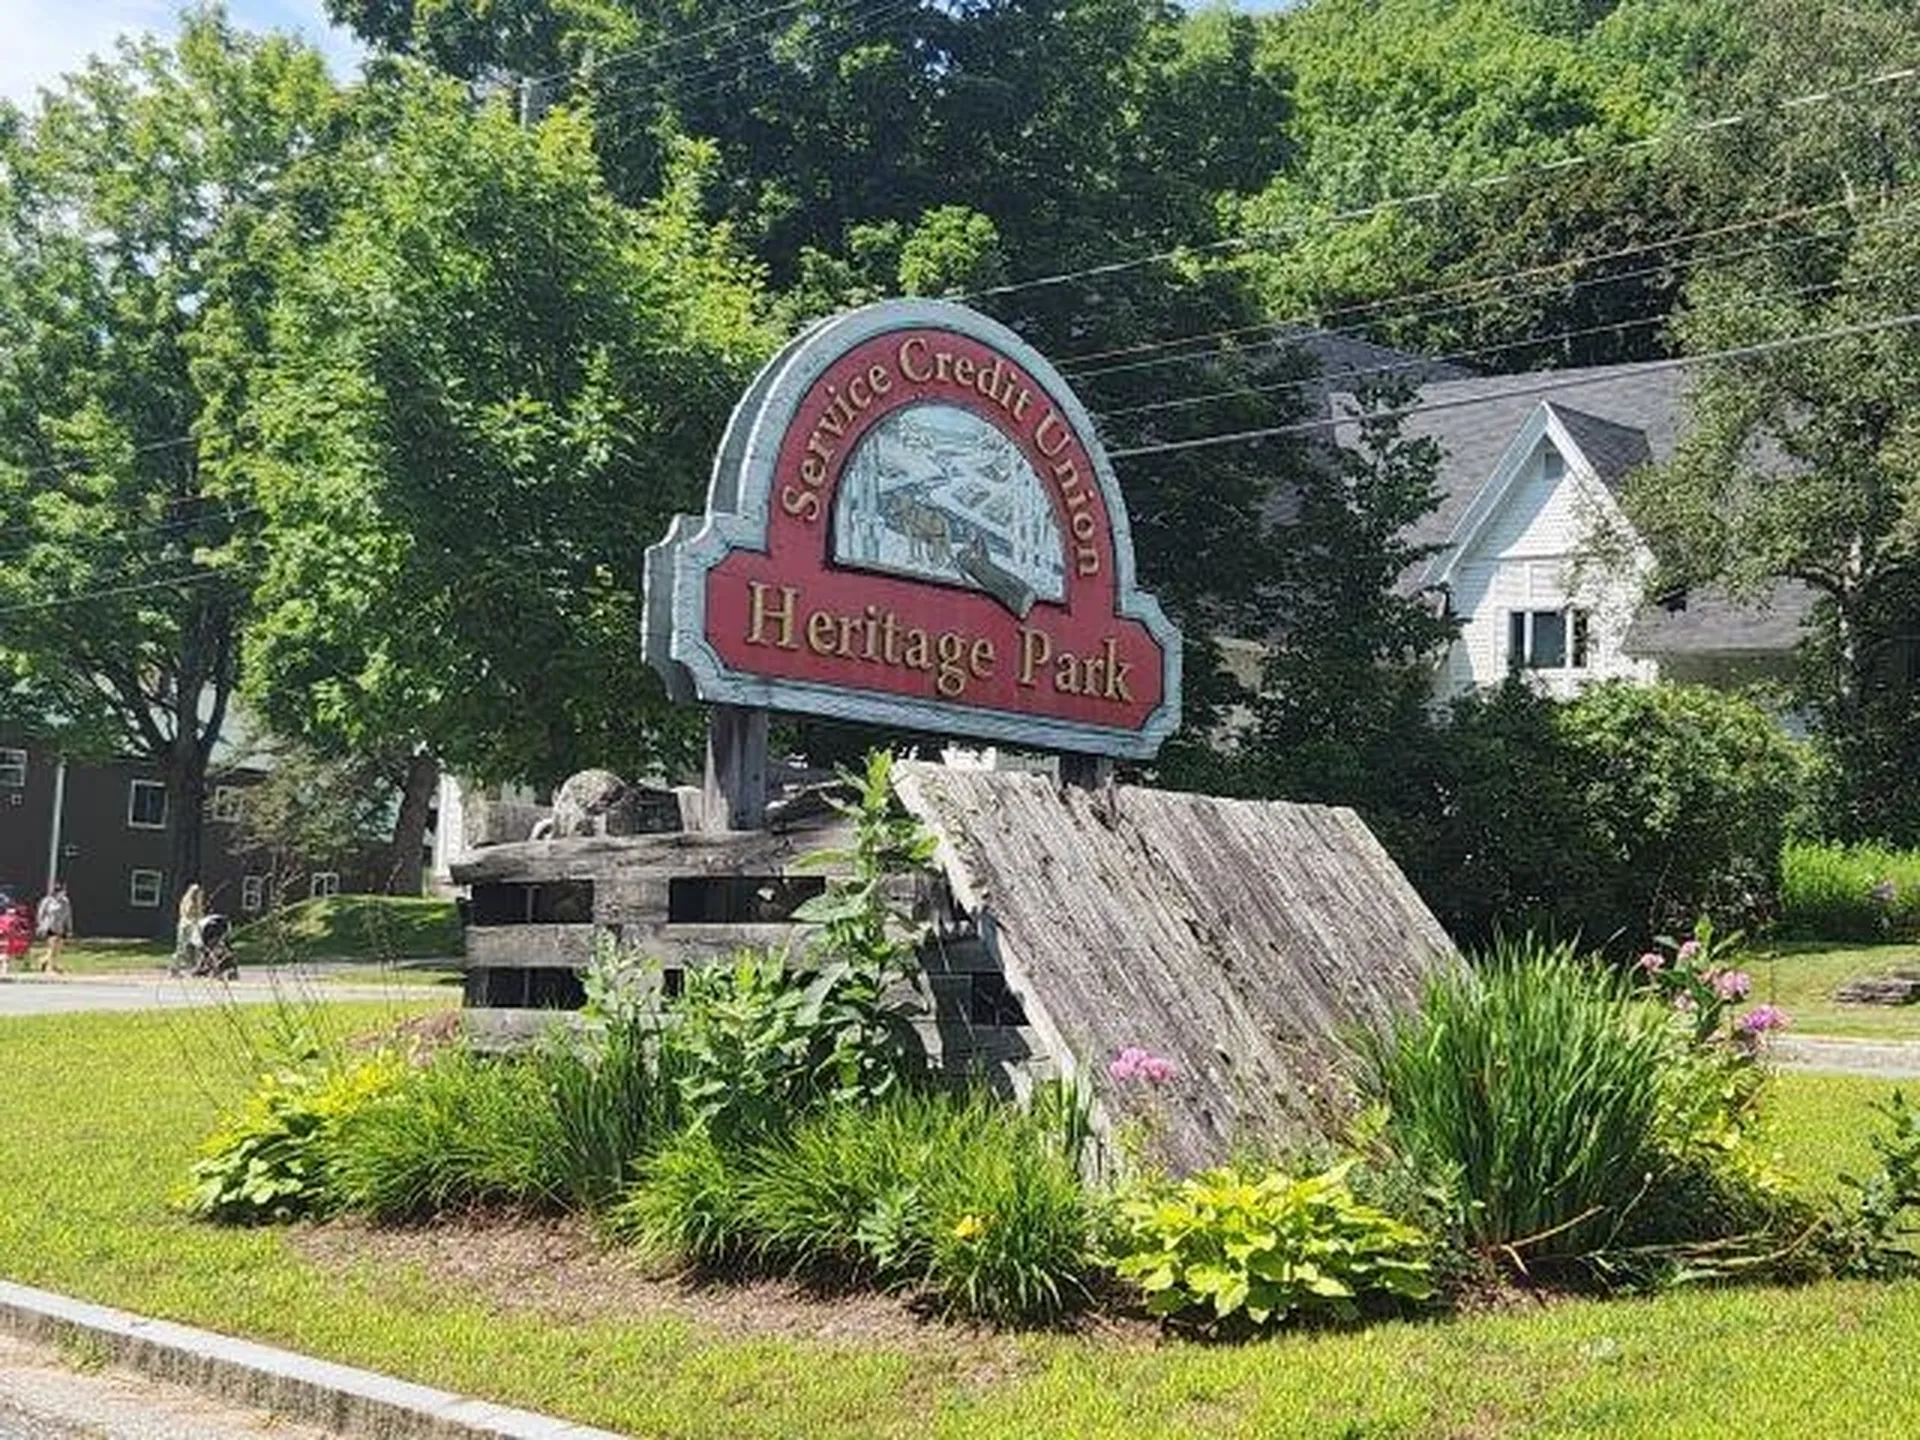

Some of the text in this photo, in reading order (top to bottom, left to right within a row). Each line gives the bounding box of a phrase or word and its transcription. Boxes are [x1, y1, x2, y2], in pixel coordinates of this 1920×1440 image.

[782, 337, 1100, 577] Service Credit Union
[746, 580, 1132, 703] Heritage Park
